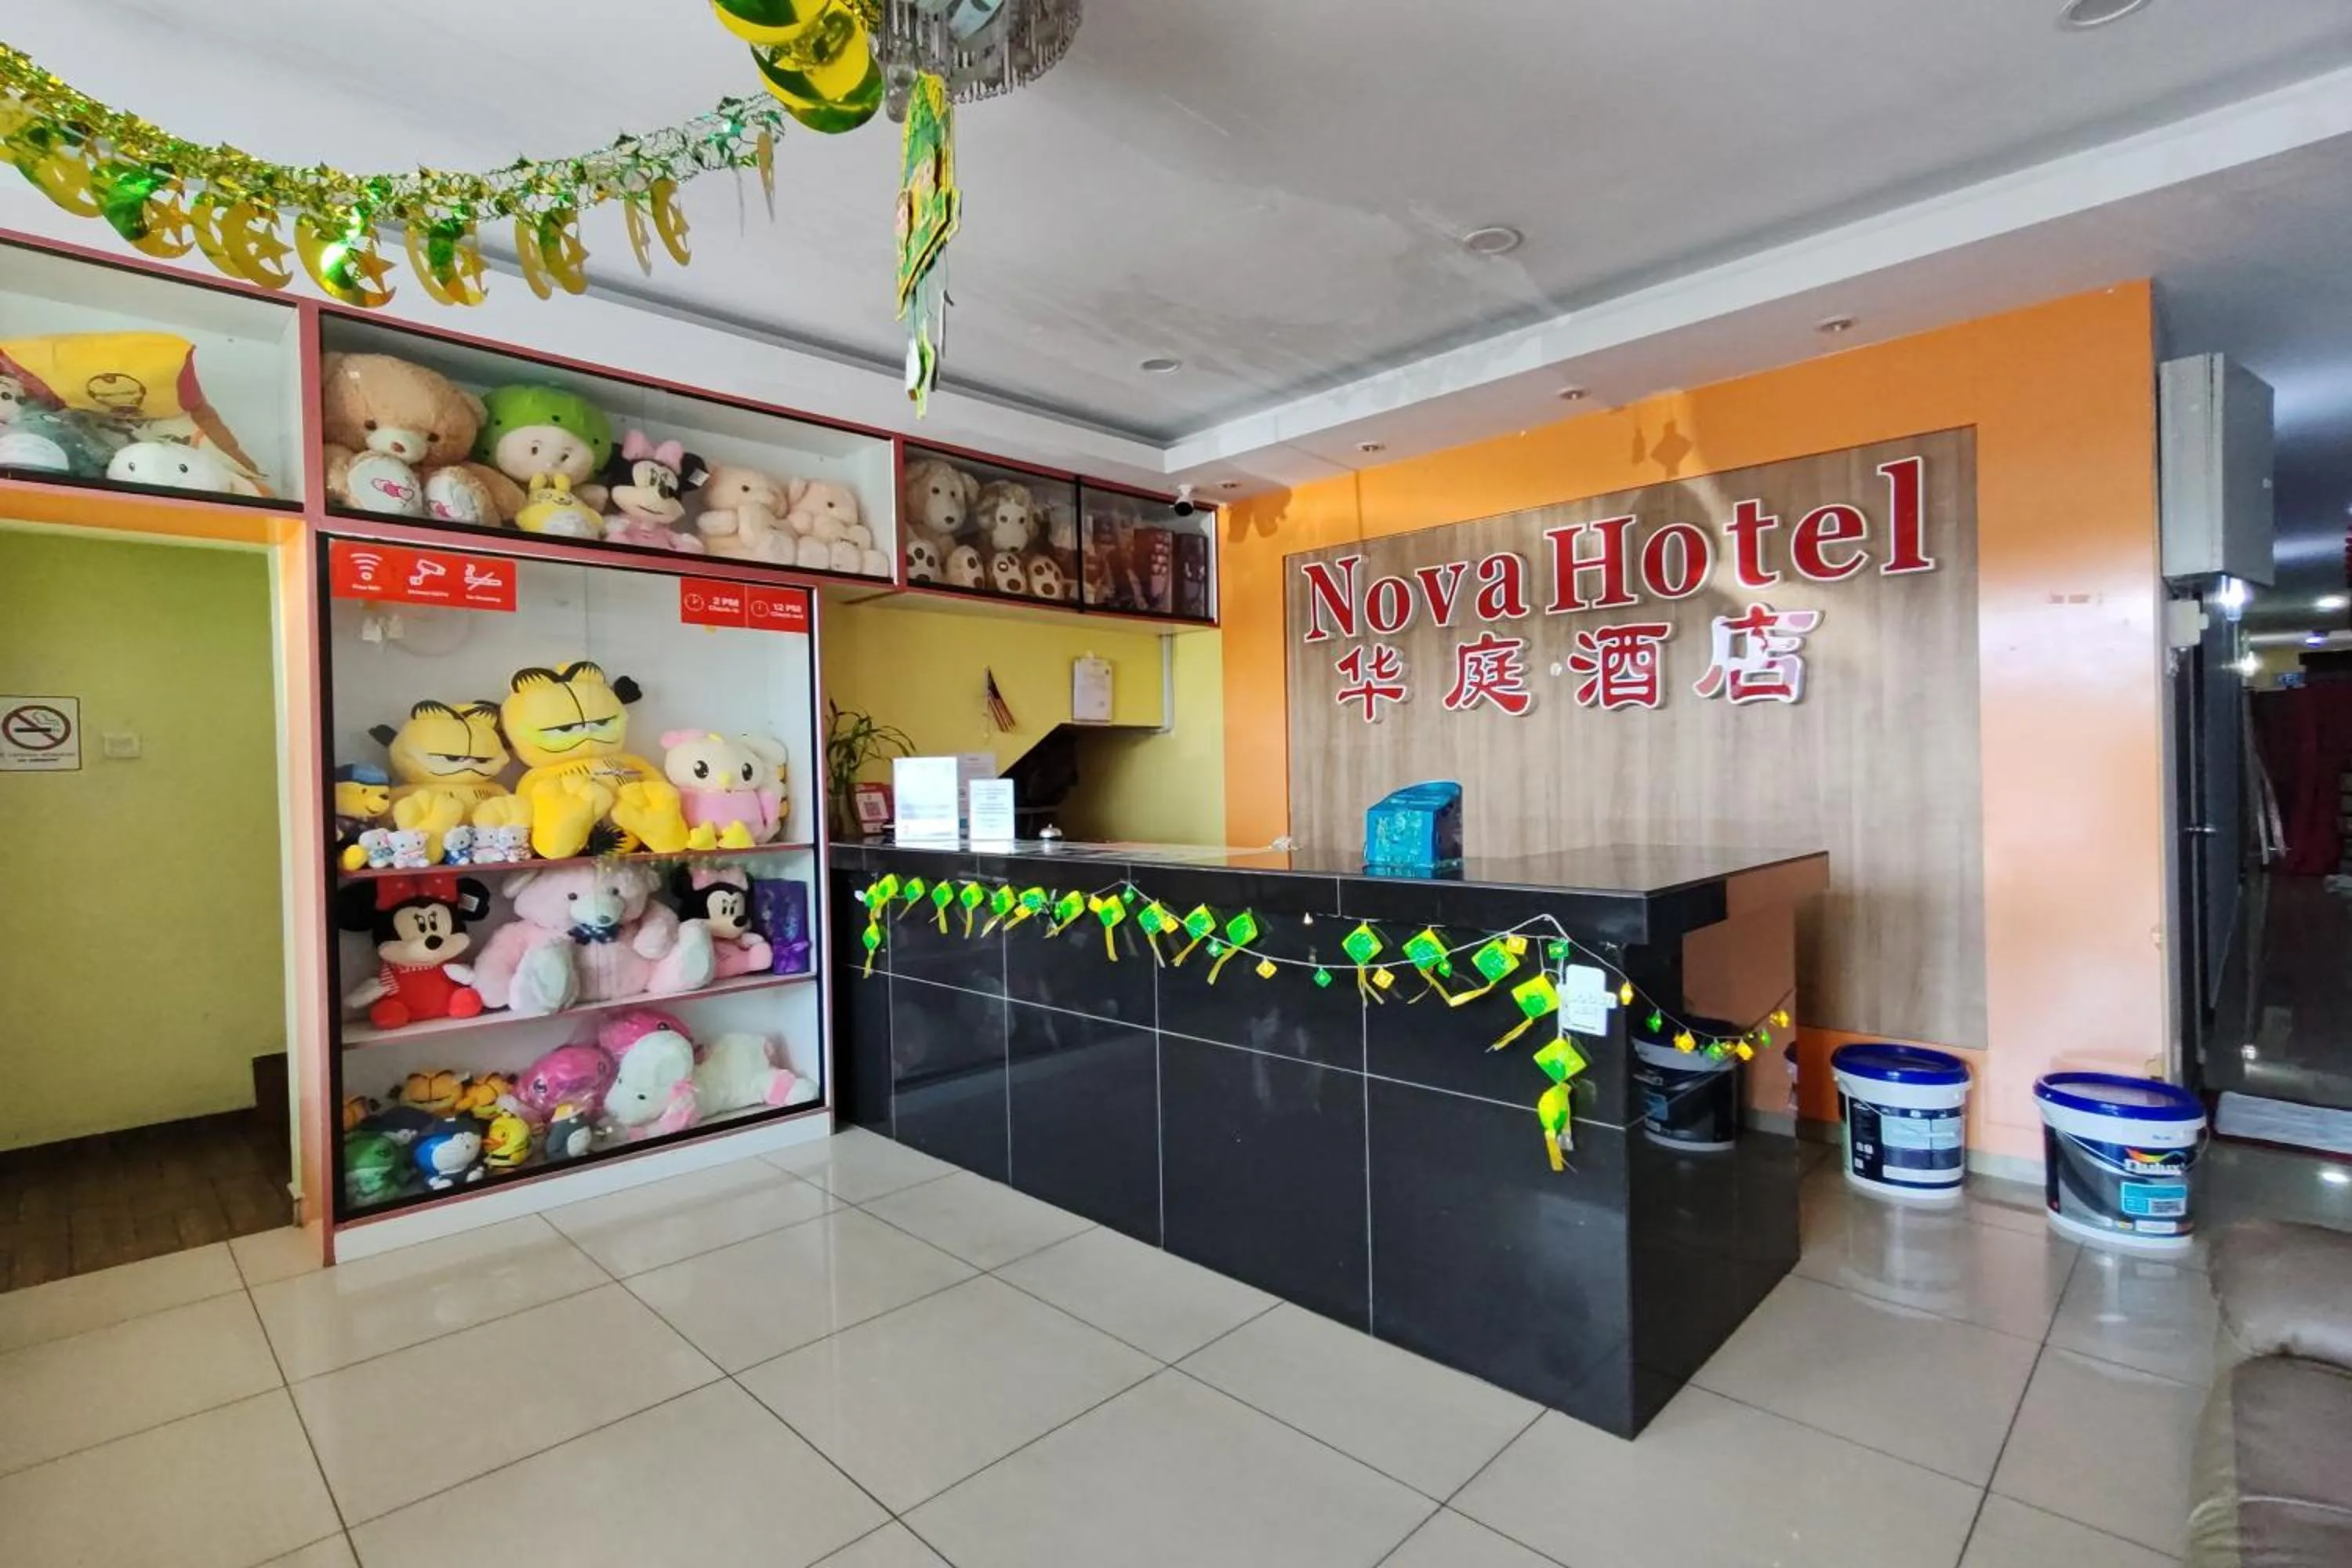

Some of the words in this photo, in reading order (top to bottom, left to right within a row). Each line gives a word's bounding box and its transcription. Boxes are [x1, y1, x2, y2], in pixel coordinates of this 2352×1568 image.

[1302, 551, 1530, 644] Nova
[1545, 456, 1936, 615] Hotel
[1336, 602, 1824, 722] 华庭酒店
